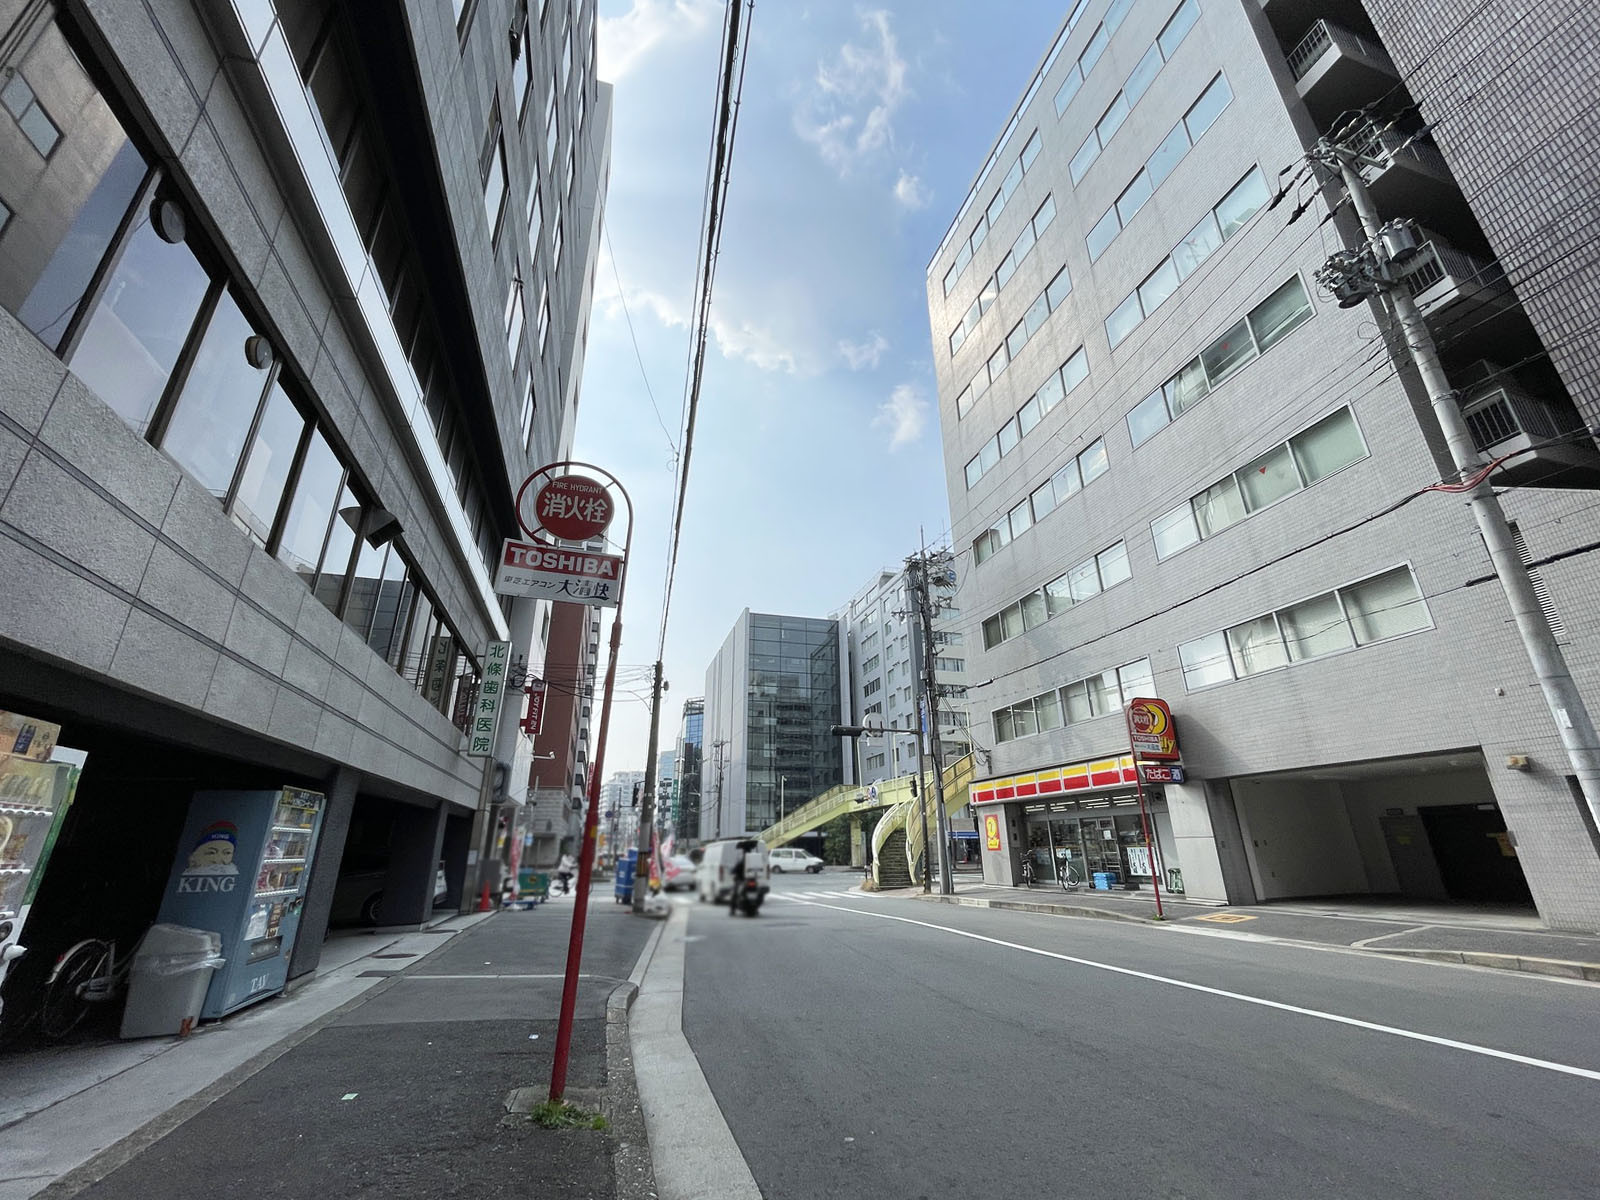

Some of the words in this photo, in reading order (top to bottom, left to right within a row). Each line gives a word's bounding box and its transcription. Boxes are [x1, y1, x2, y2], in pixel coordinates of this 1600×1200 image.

[552, 481, 569, 490] FIRE
[570, 484, 602, 494] HYDRANT
[541, 492, 608, 523] 消火栓
[510, 547, 614, 577] TOSHIBA
[556, 579, 610, 600] 大清快
[472, 644, 505, 752] 北條歯科医院
[1146, 768, 1172, 780] たばこ
[177, 876, 236, 893] KING
